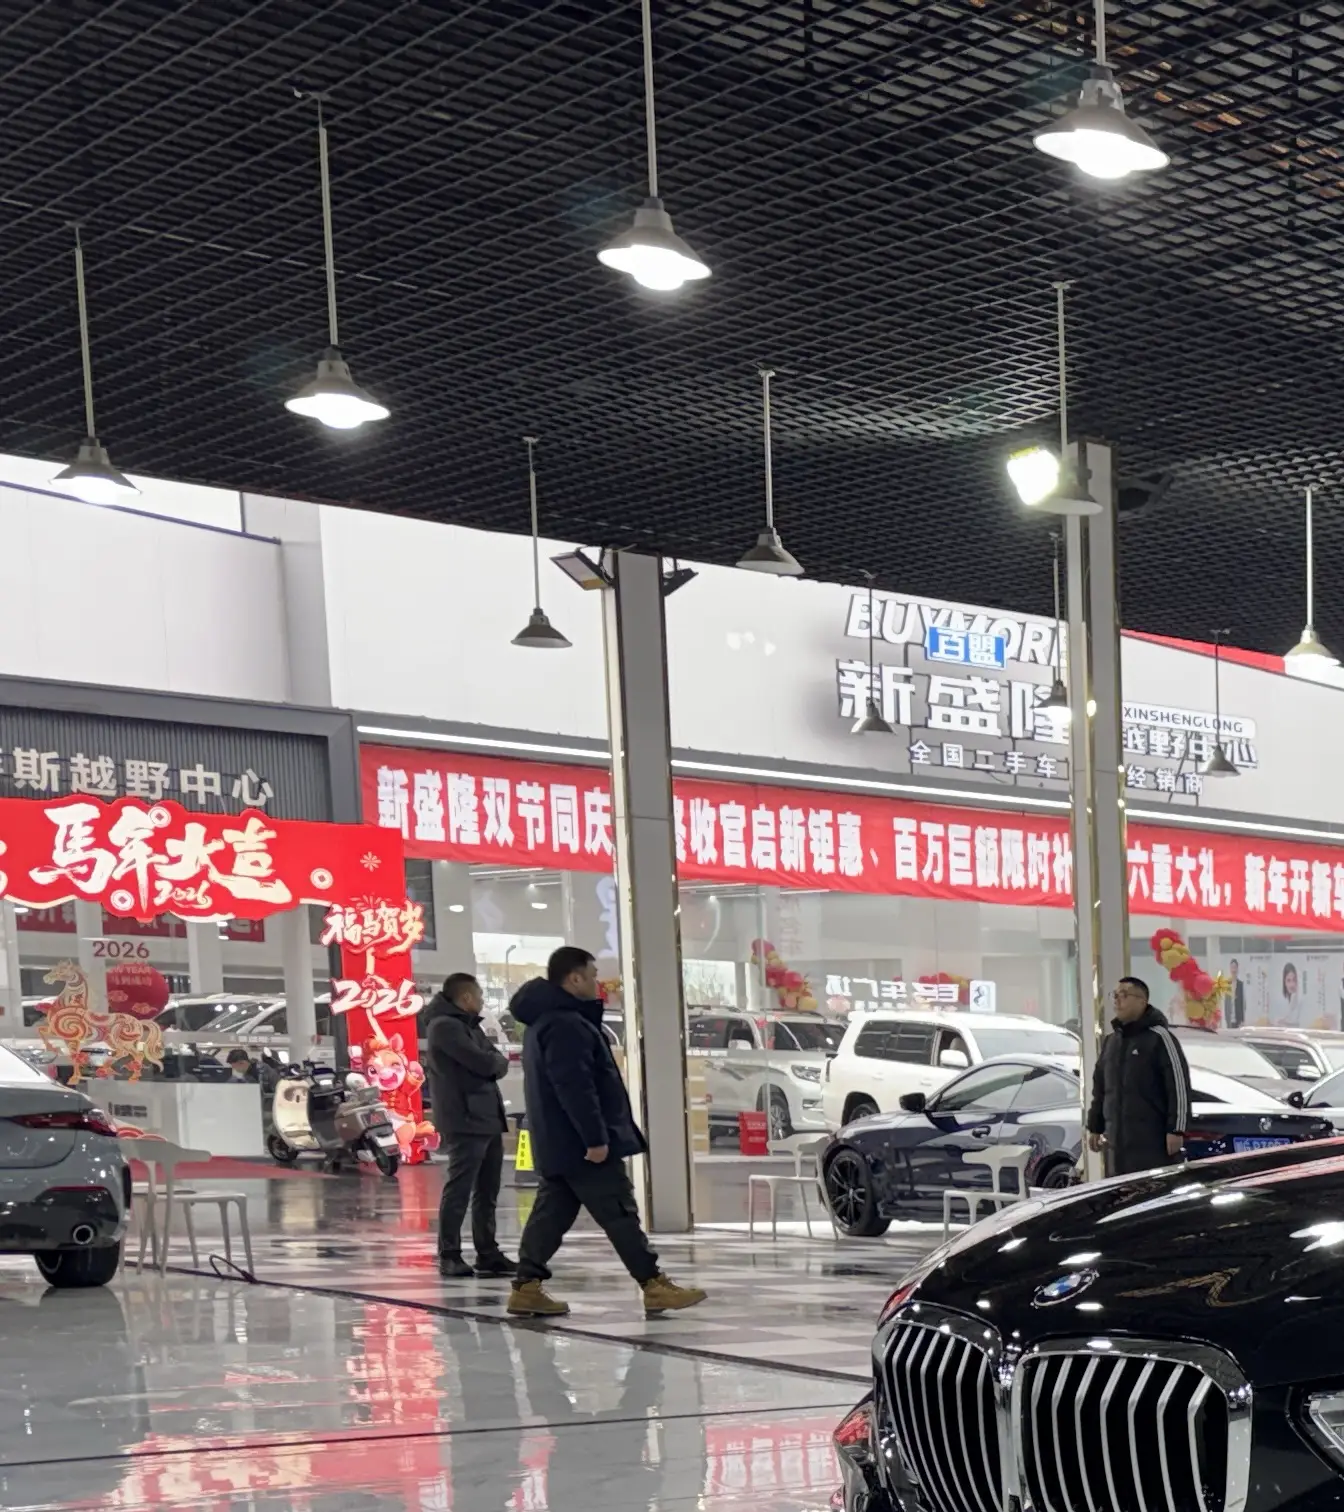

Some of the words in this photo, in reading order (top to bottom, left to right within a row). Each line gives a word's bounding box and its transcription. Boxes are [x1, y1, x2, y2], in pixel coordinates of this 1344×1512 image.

[933, 627, 1001, 666] 百盟
[837, 659, 1070, 744] 新盛隆
[1124, 706, 1243, 733] XINSHENGLONG
[0, 747, 274, 807] 斯越野中心
[909, 740, 1057, 778] 全国二手车
[93, 940, 150, 959] 2026
[330, 979, 424, 1016] 2026
